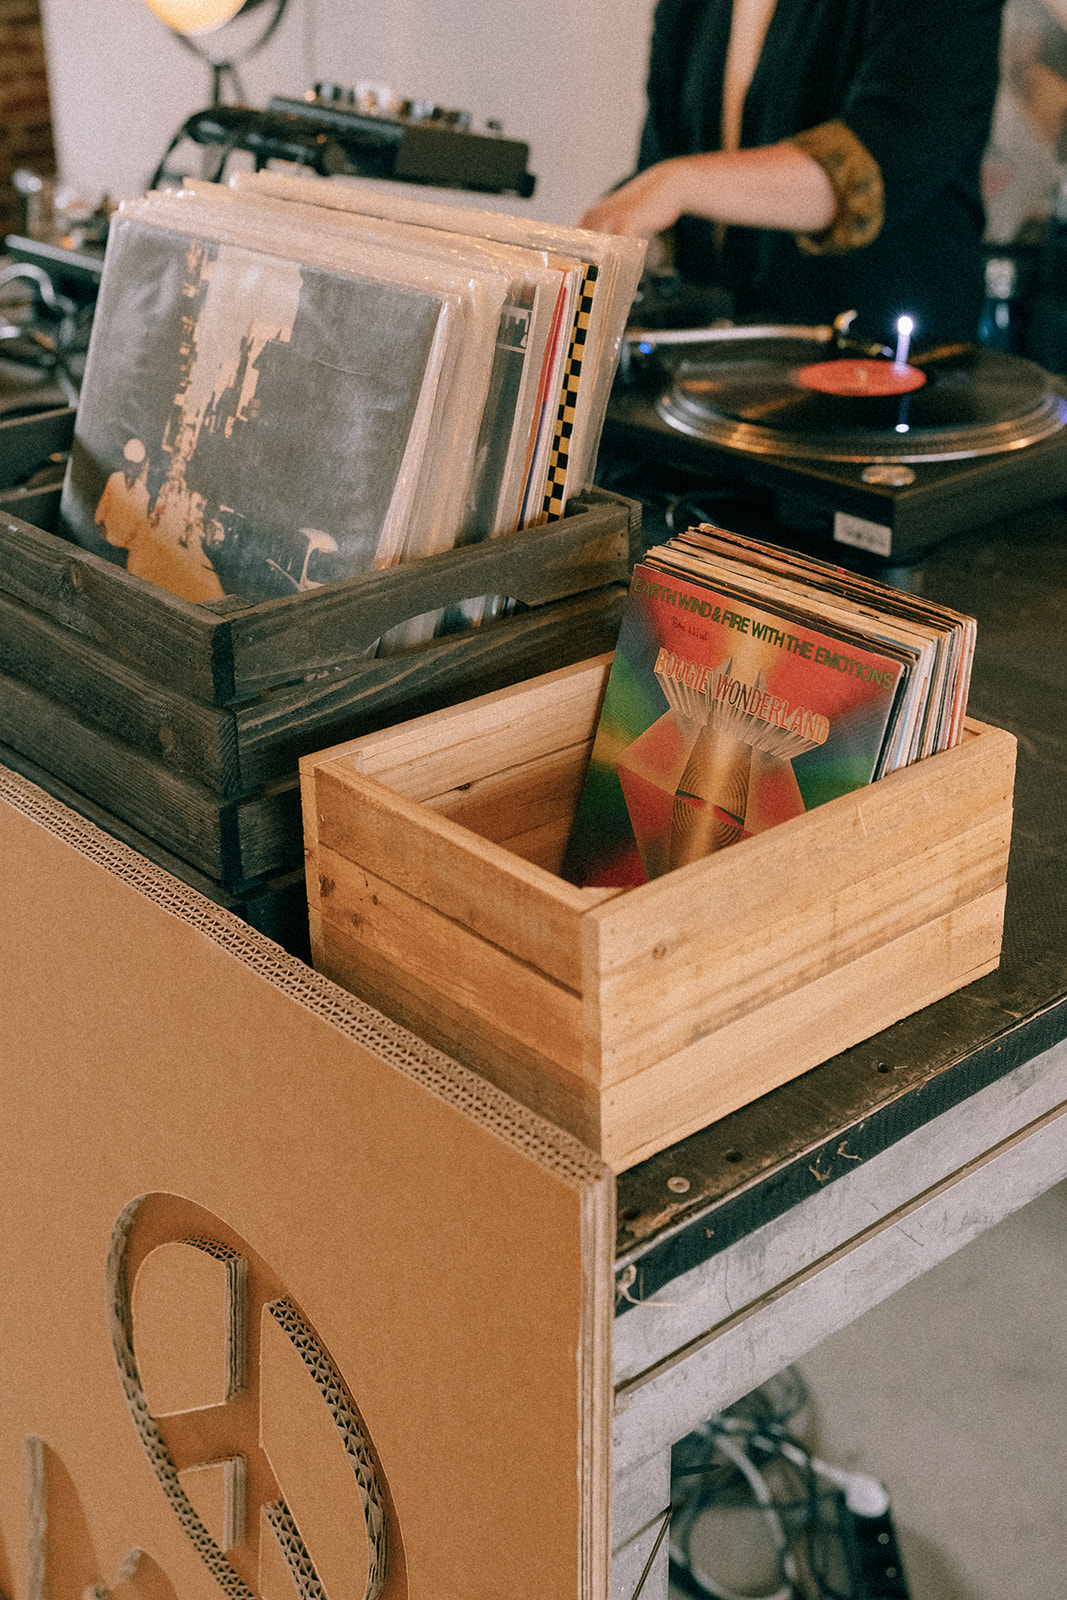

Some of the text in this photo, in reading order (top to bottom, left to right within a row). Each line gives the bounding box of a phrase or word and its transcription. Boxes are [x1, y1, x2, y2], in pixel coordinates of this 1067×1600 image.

[634, 577, 677, 606] EARTH
[678, 592, 713, 618] WIND
[721, 609, 751, 635] FIRE
[751, 620, 785, 648] WITH
[787, 634, 814, 660] THE
[814, 646, 894, 690] EMOTIONS
[655, 648, 829, 744] BOOGIE WONDERLAND
